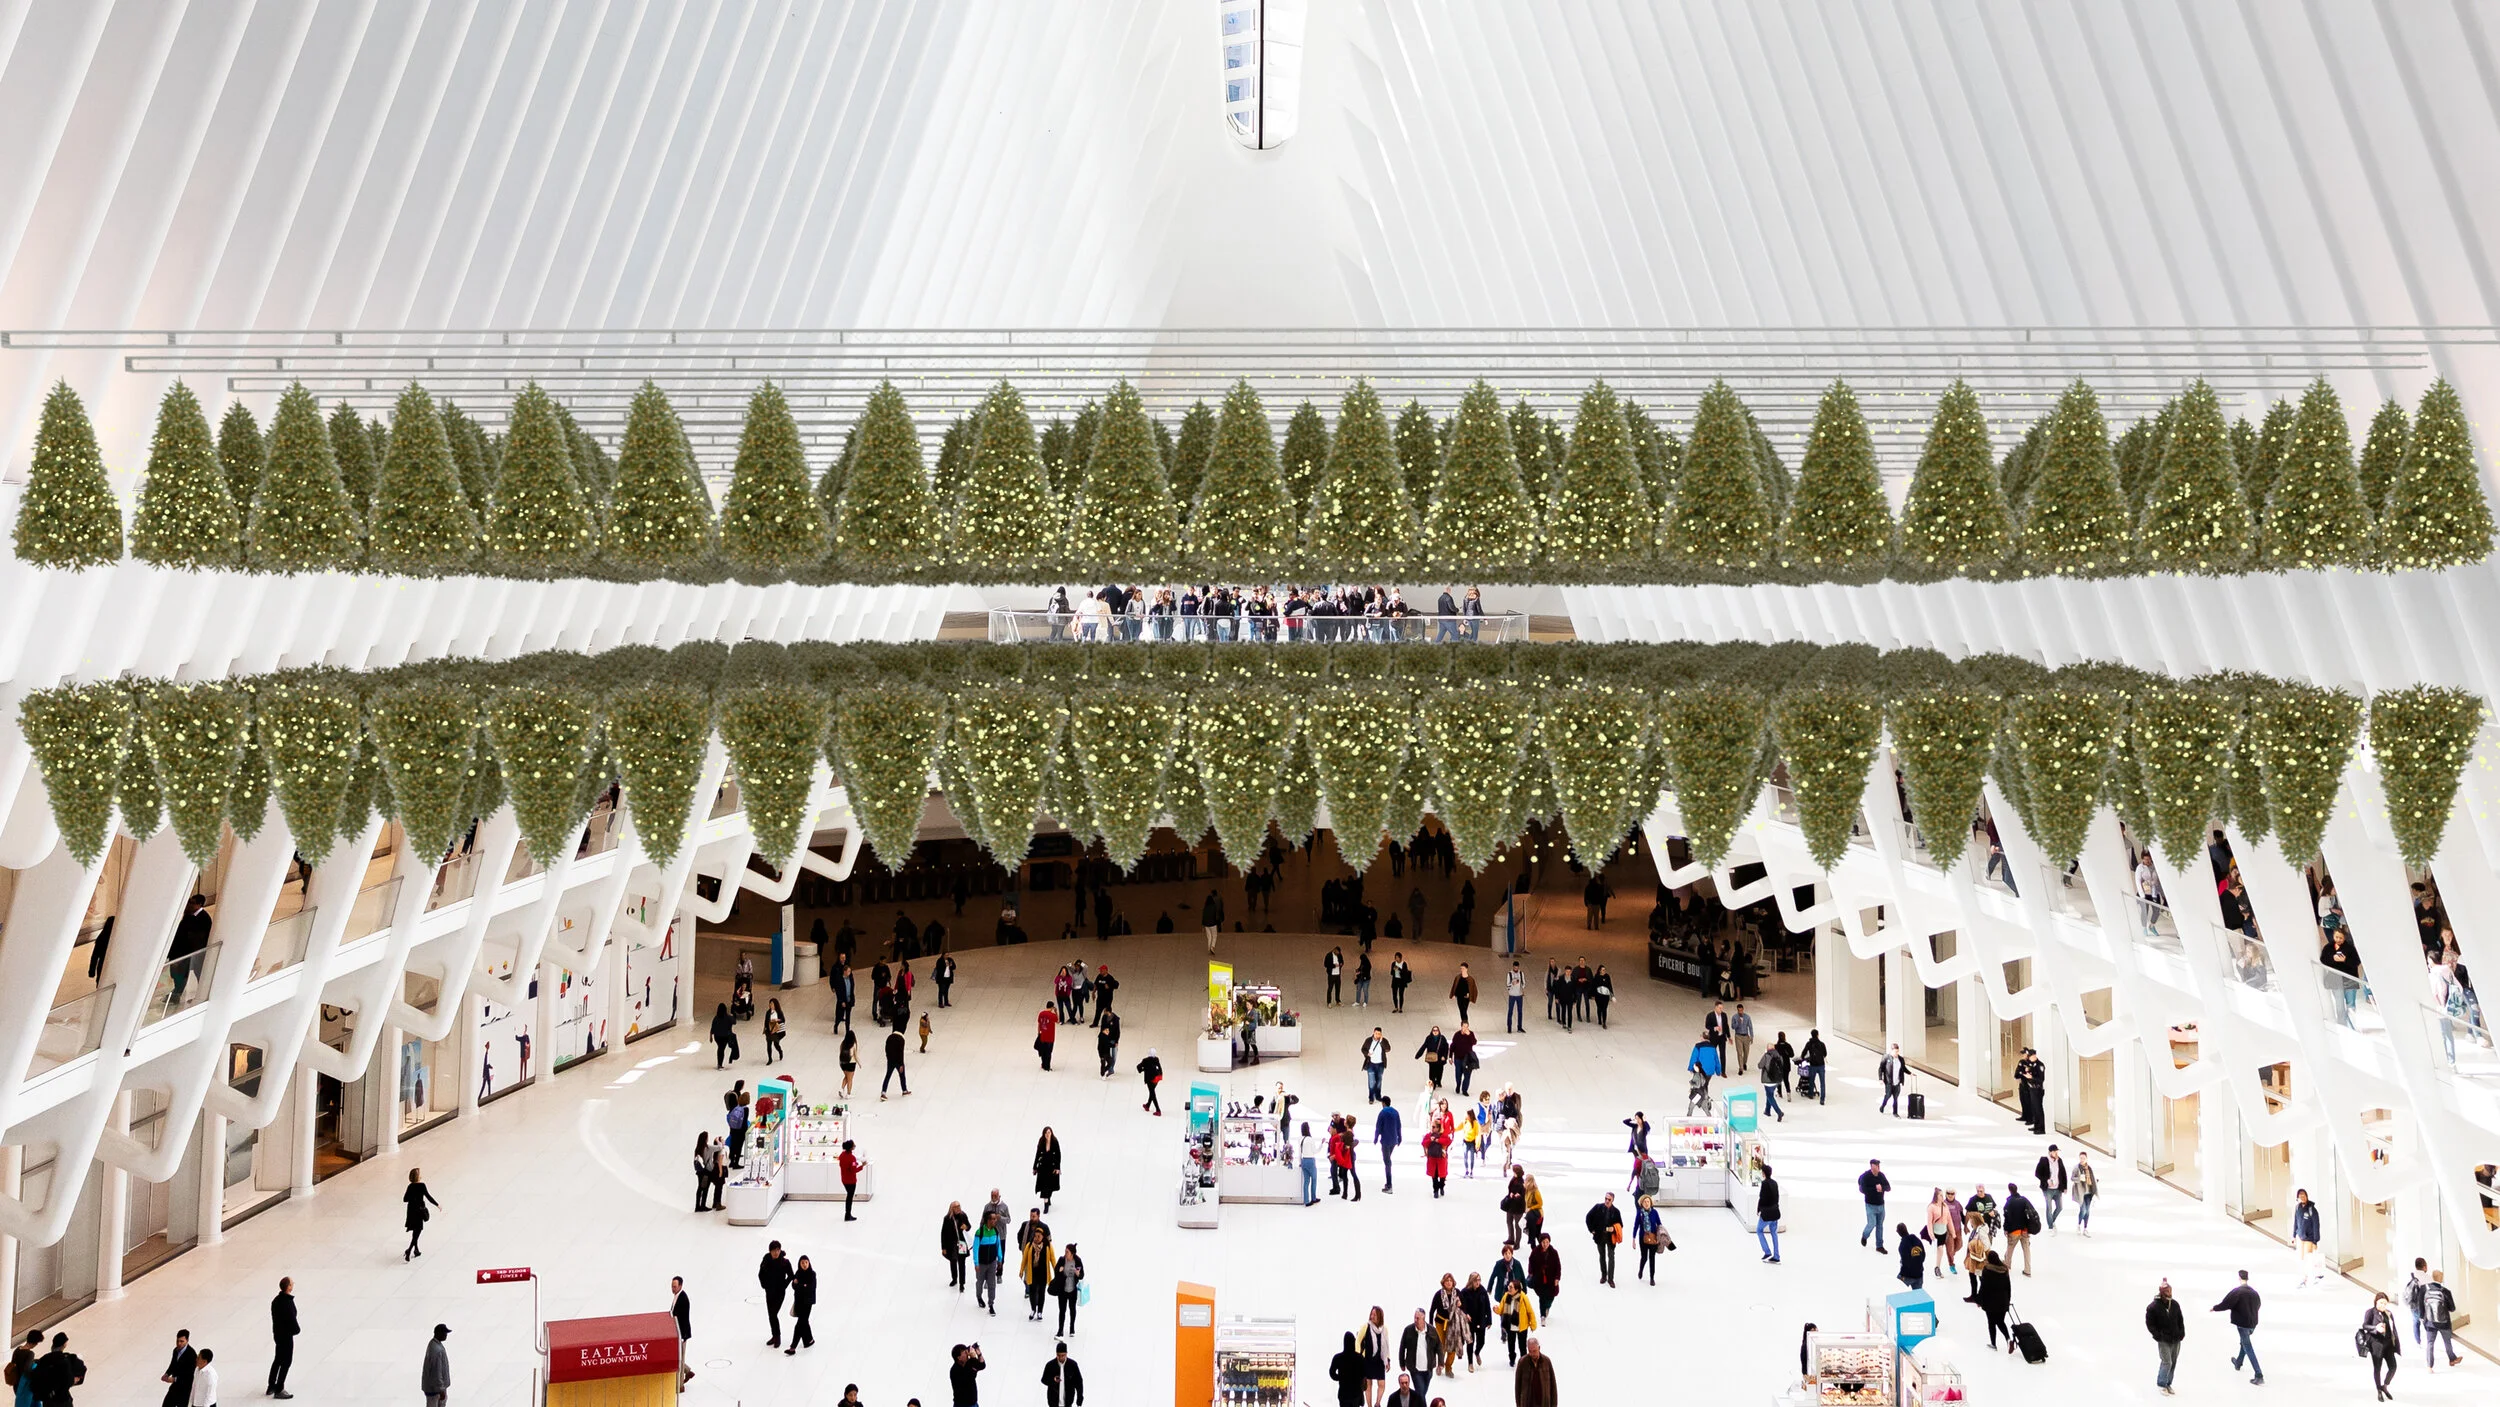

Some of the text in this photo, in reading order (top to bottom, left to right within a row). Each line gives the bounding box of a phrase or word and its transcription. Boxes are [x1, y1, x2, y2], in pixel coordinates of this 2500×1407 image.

[1658, 953, 1700, 977] ÉPICERIE BOU
[581, 1343, 648, 1359] EATALY
[600, 1354, 648, 1365] DOWNTOWN
